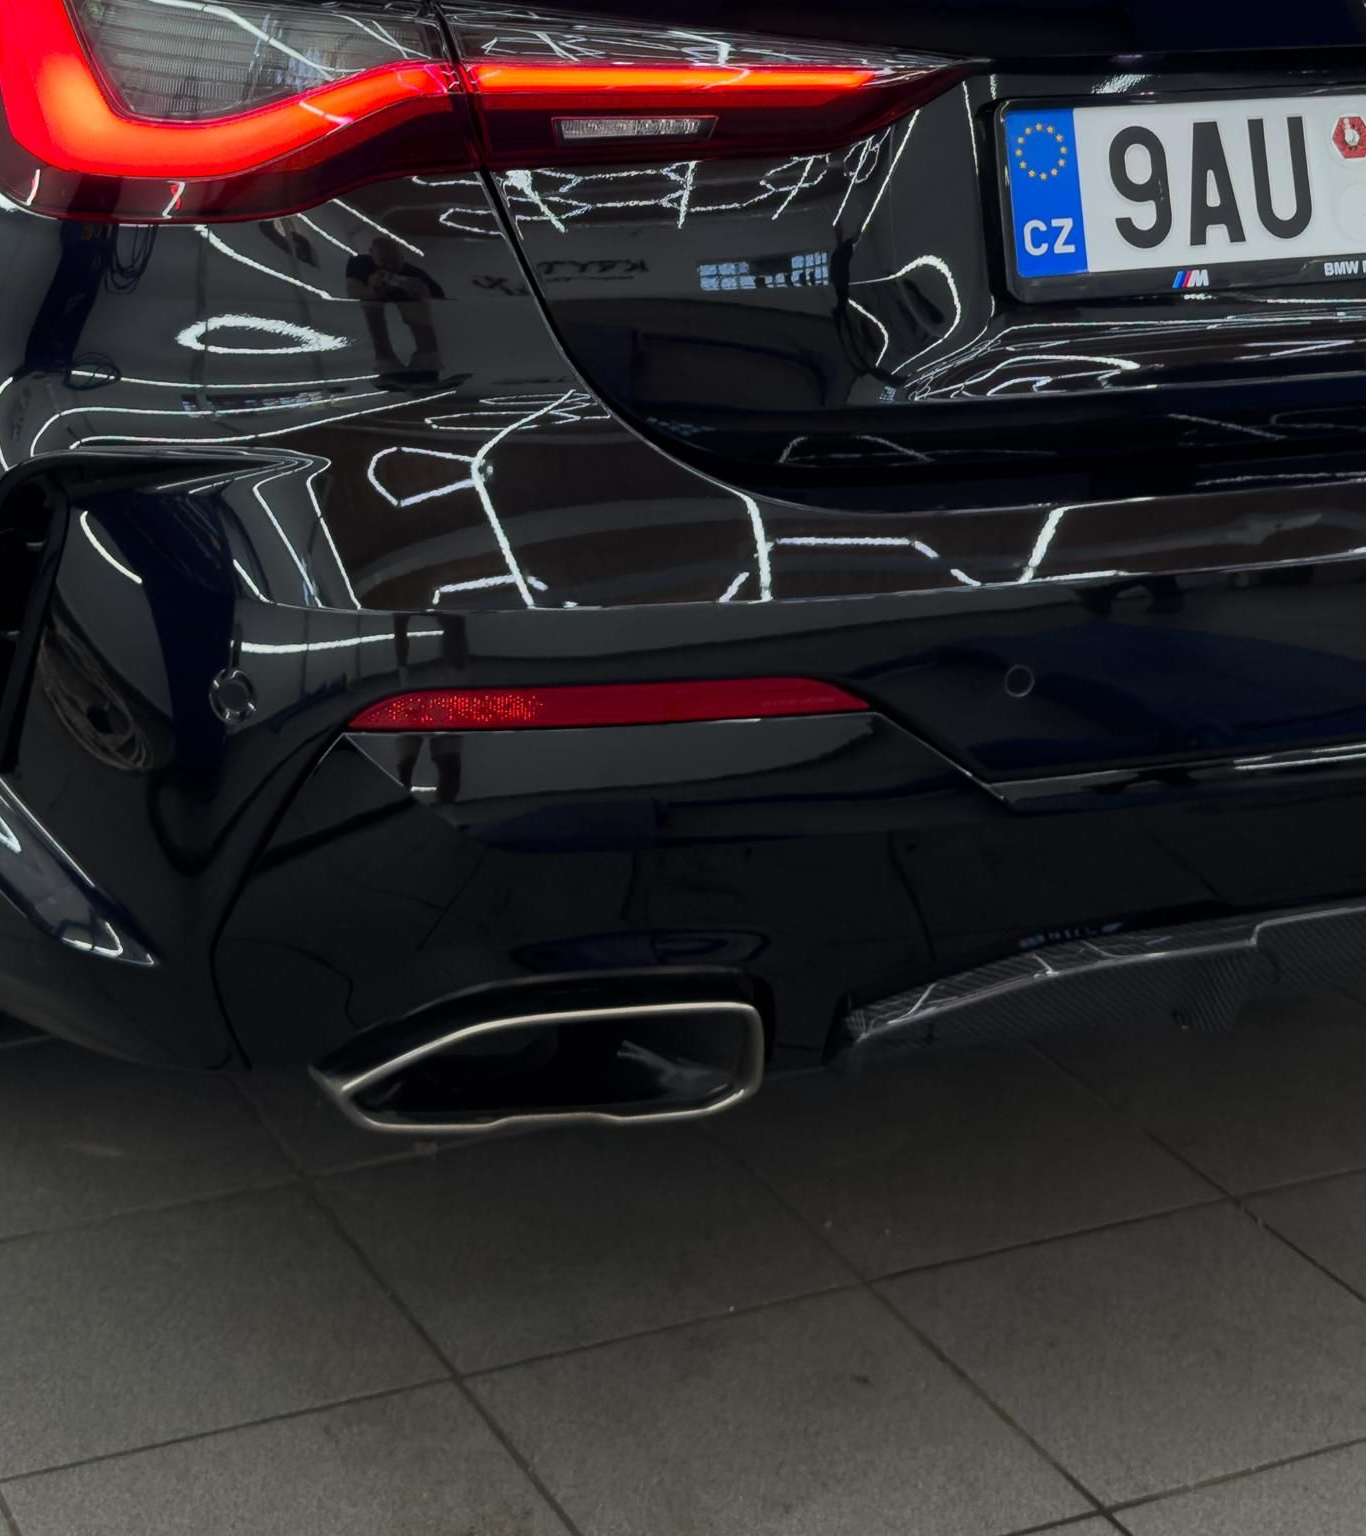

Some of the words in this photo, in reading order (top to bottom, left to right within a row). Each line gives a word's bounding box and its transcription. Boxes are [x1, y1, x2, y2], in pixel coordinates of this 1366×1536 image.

[1109, 116, 1313, 249] 9AU
[1023, 218, 1076, 256] CZ
[1324, 260, 1359, 277] BMW
